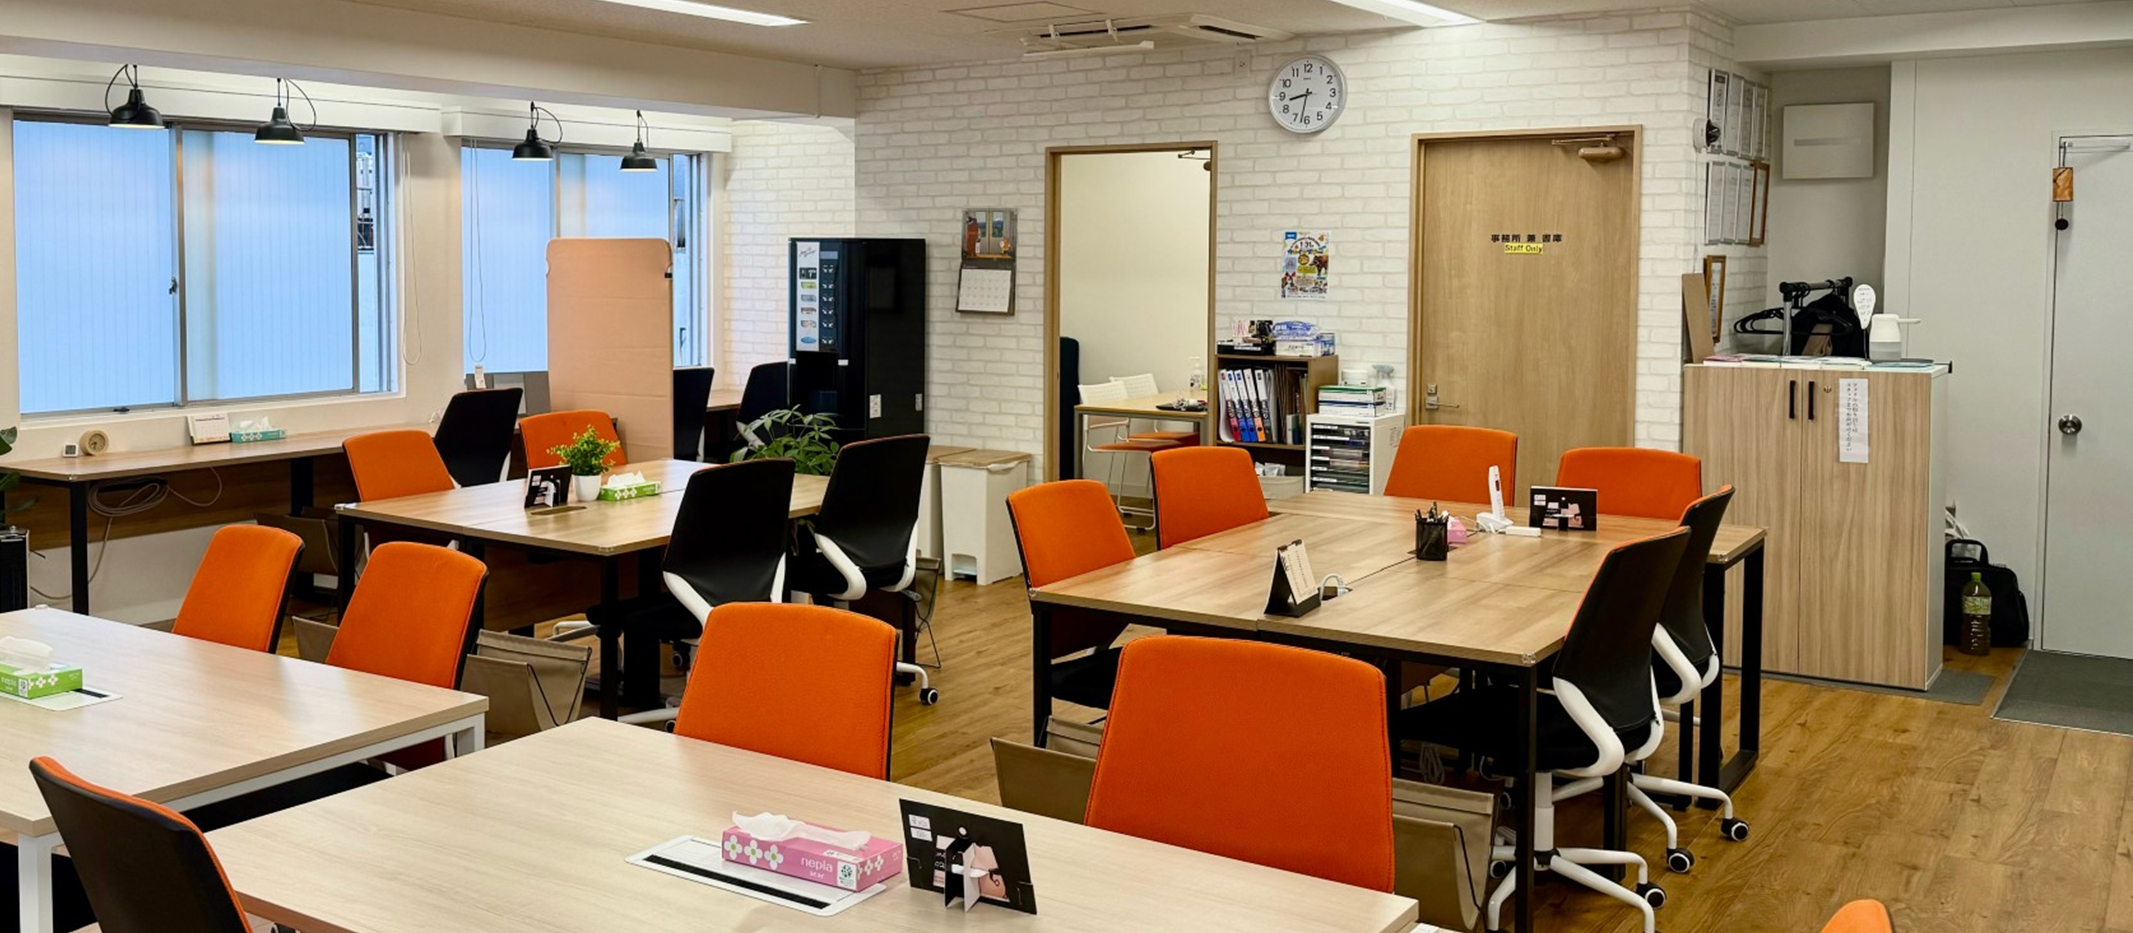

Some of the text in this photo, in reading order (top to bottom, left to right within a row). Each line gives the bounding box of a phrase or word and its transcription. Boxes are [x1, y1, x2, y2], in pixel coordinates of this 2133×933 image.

[1292, 67, 1299, 77] 11
[1303, 63, 1313, 73] 12
[1282, 78, 1292, 88] 10
[1326, 75, 1333, 84] 2
[1279, 91, 1286, 102] 9
[1330, 87, 1336, 97] 3
[1282, 104, 1290, 114] 8
[1325, 101, 1332, 110] 4
[1292, 112, 1299, 122] 7
[1303, 115, 1311, 125] 6
[1316, 111, 1323, 121] 5
[1491, 234, 1521, 243] 事務所
[1505, 244, 1542, 253] Staff Only
[801, 857, 833, 872] nepia
